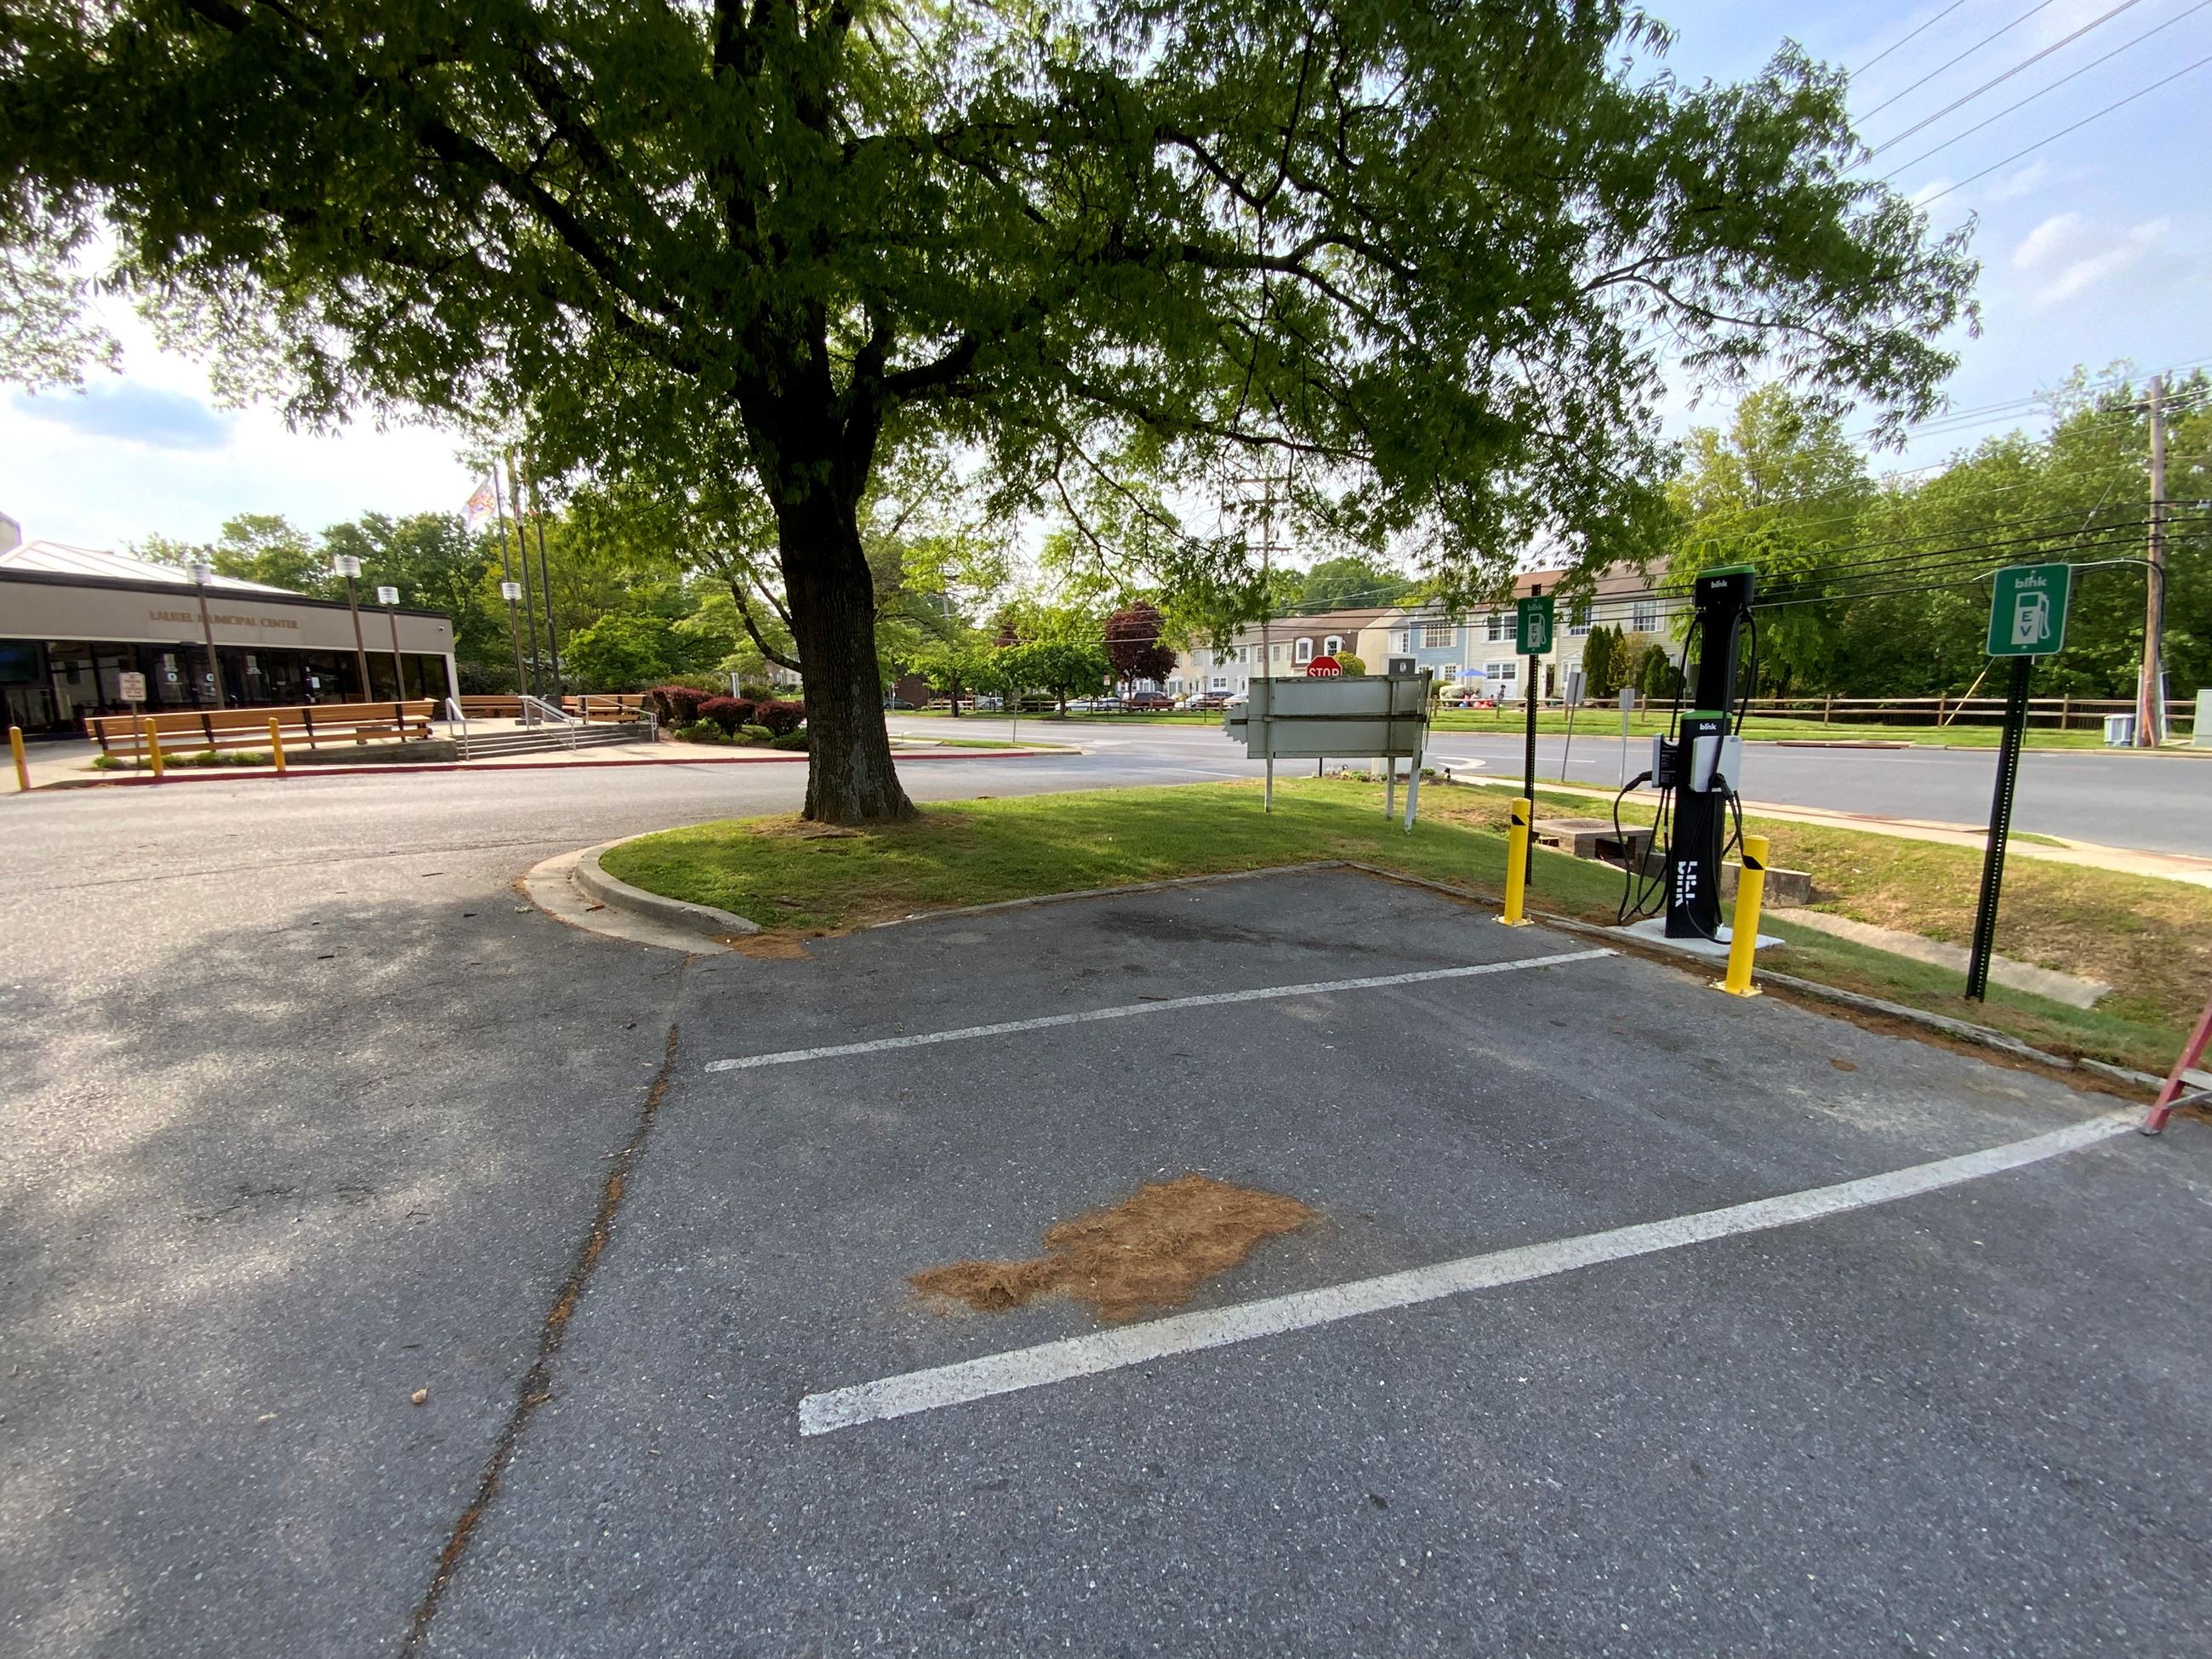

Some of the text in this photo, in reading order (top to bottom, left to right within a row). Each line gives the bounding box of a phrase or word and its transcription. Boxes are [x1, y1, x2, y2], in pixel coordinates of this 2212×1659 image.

[1710, 580, 1728, 589] blink
[2015, 576, 2047, 589] blink
[1527, 603, 1544, 612] blink
[259, 618, 299, 630] CENTER
[1308, 667, 1340, 677] STOP
[1699, 722, 1718, 731] blink
[1675, 861, 1698, 908] blink
